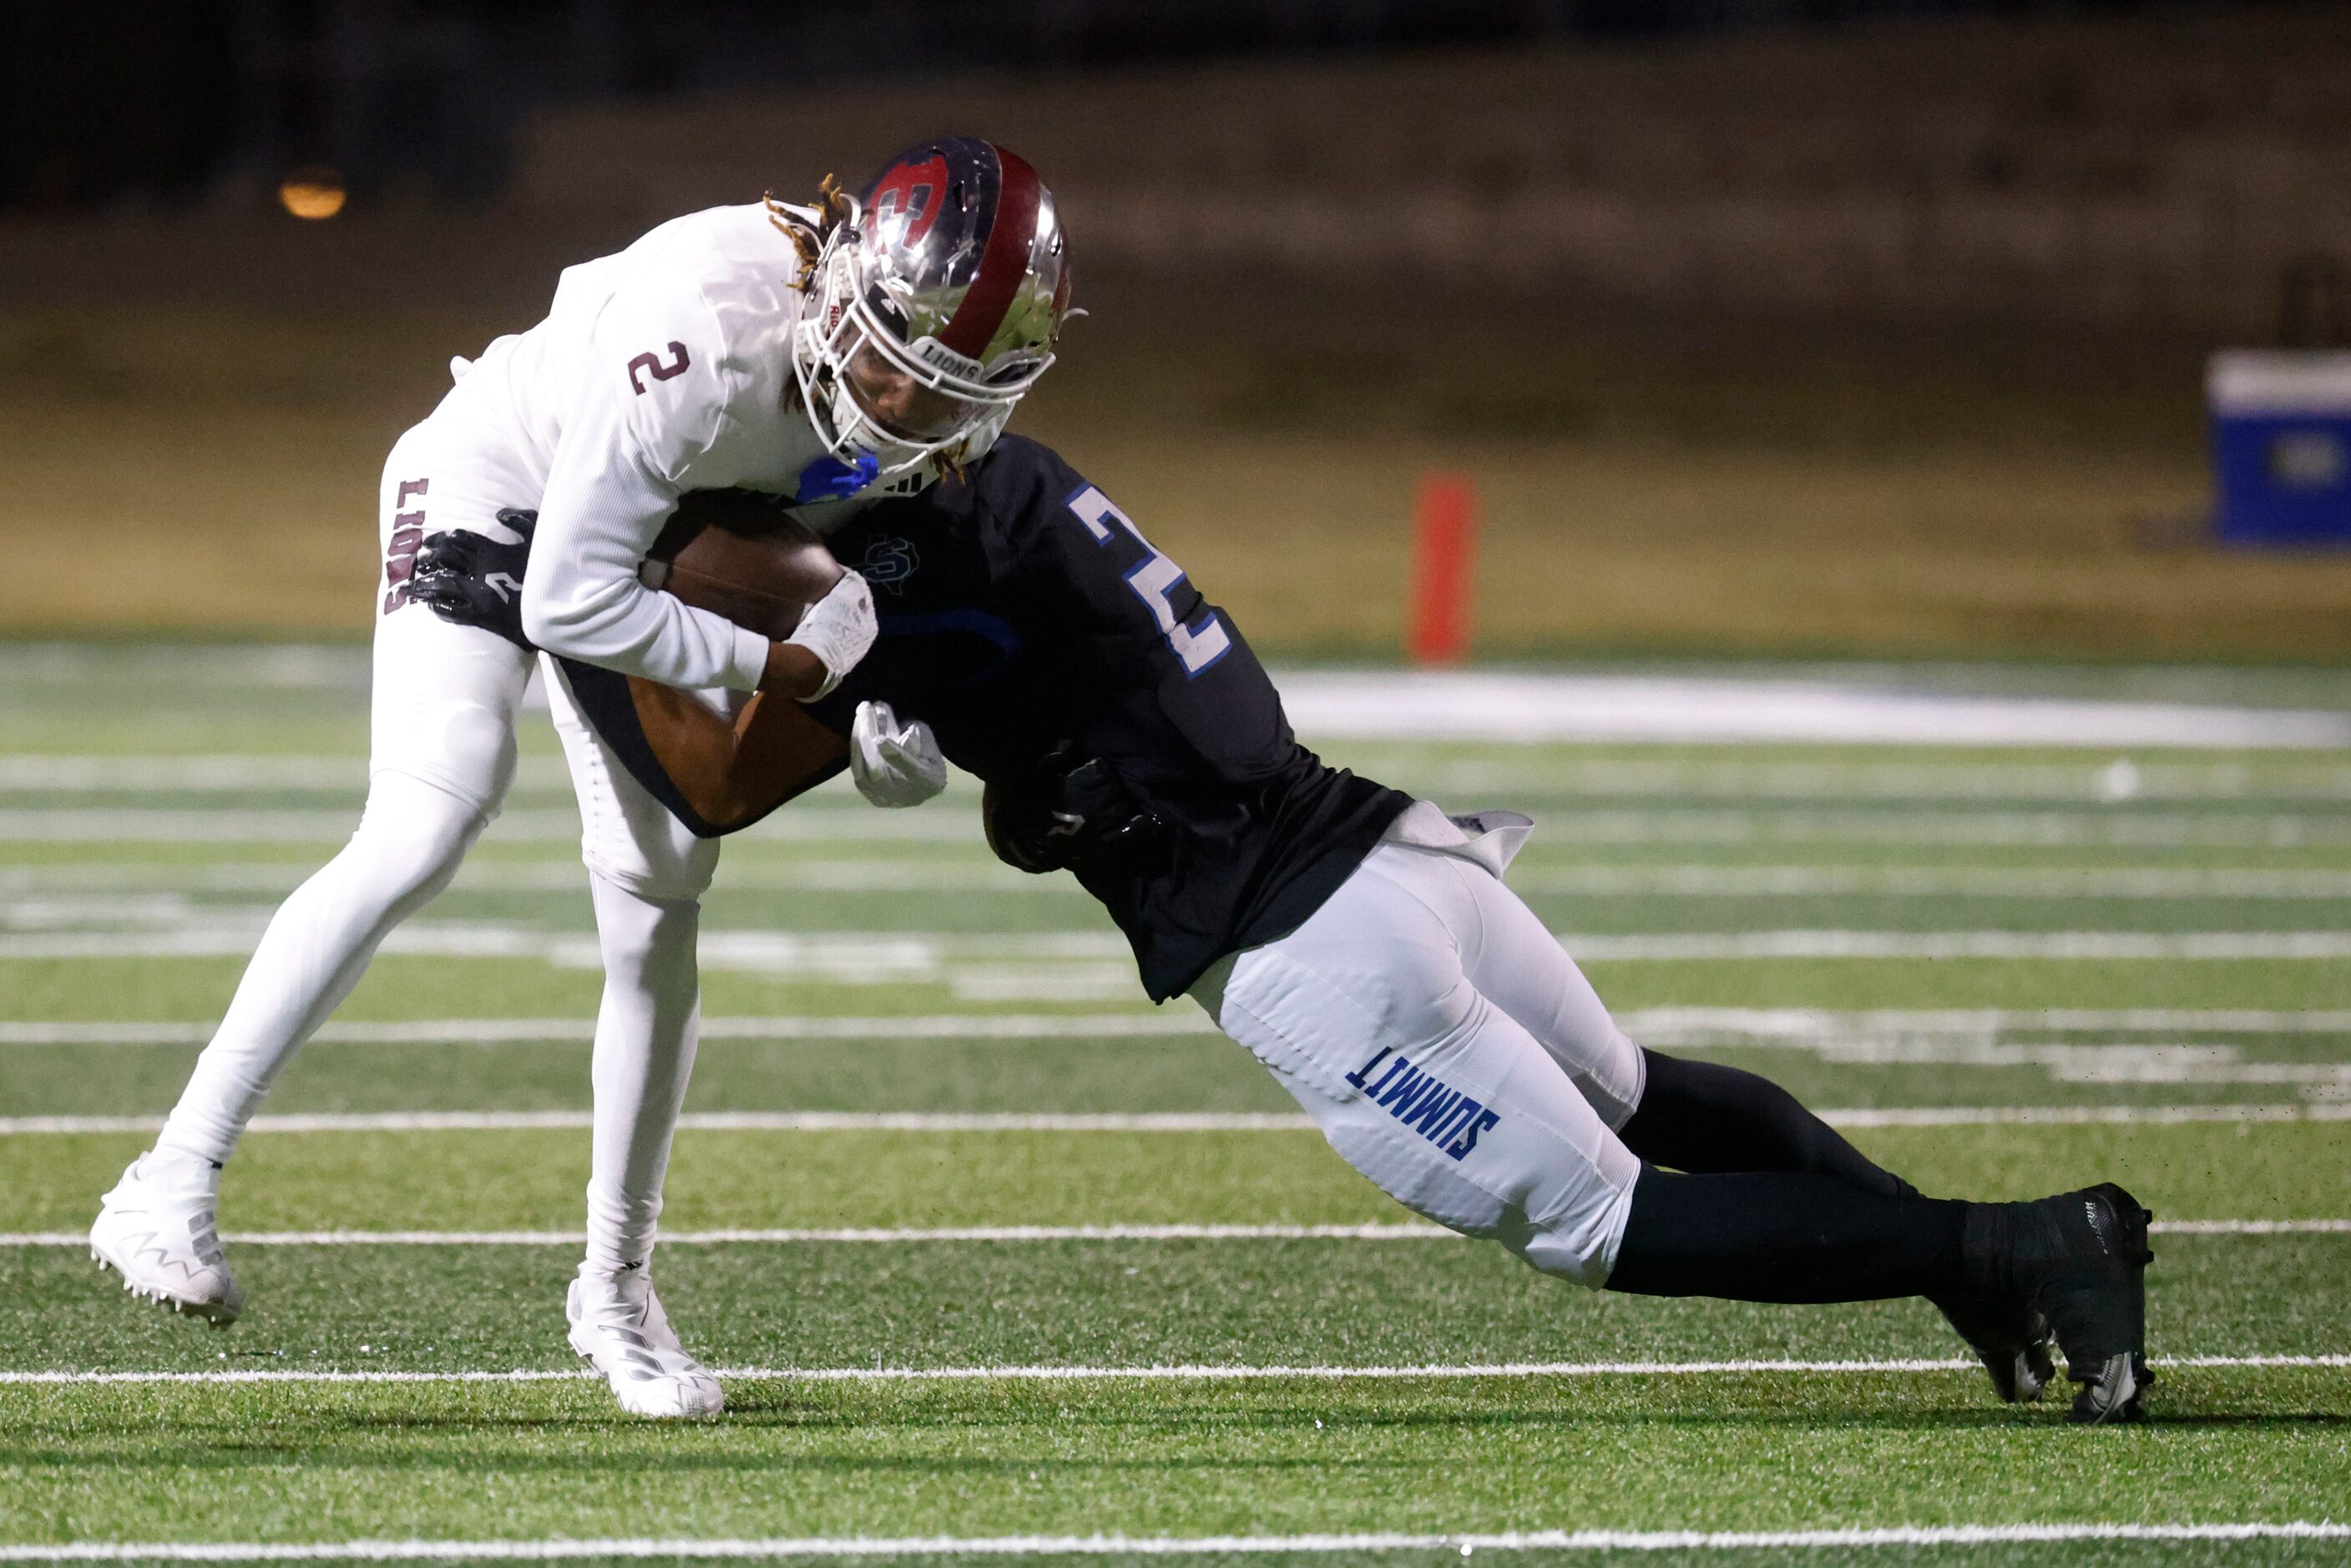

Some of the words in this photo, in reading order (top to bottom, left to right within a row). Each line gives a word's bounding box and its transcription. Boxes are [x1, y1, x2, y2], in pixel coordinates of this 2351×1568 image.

[628, 341, 690, 396] 2
[920, 344, 979, 380] LIONS
[1064, 482, 1232, 680] 2
[1344, 1045, 1501, 1161] SUMMIT
